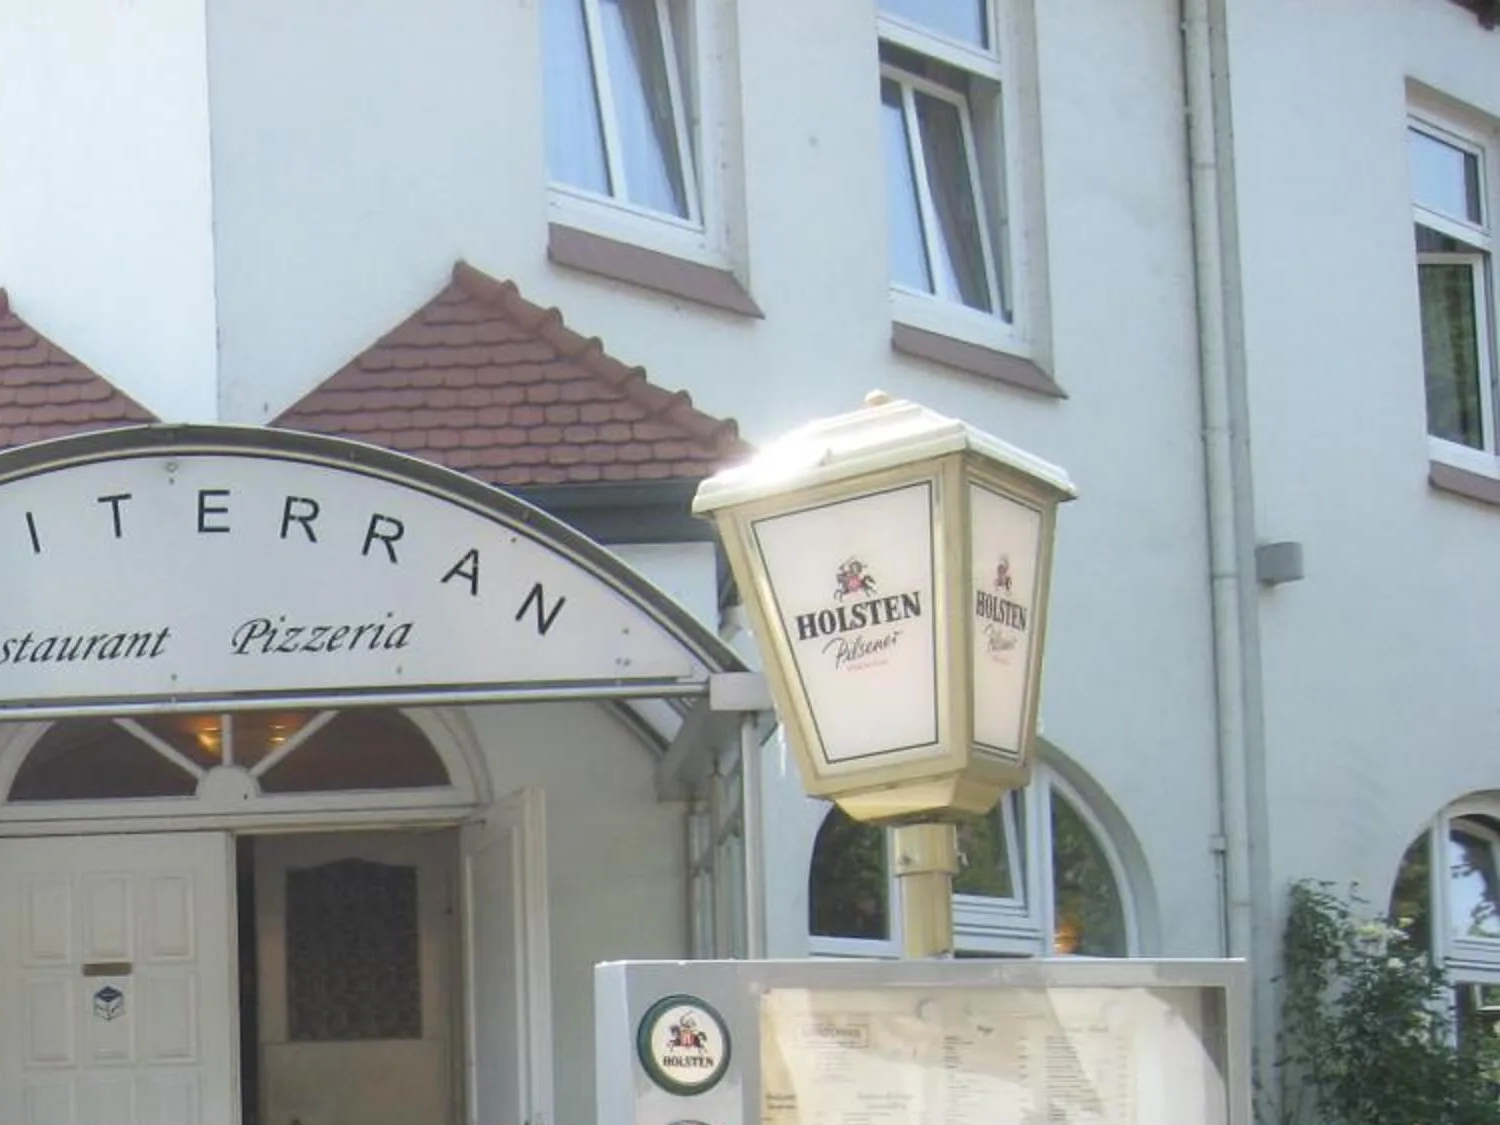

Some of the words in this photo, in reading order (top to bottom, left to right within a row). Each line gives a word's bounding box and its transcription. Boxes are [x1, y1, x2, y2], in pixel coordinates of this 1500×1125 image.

[796, 590, 922, 641] HOLSTEN
[976, 589, 1027, 632] HOLSTEN
[231, 612, 415, 655] Pizzeria
[663, 1055, 714, 1069] HOLSTEN
